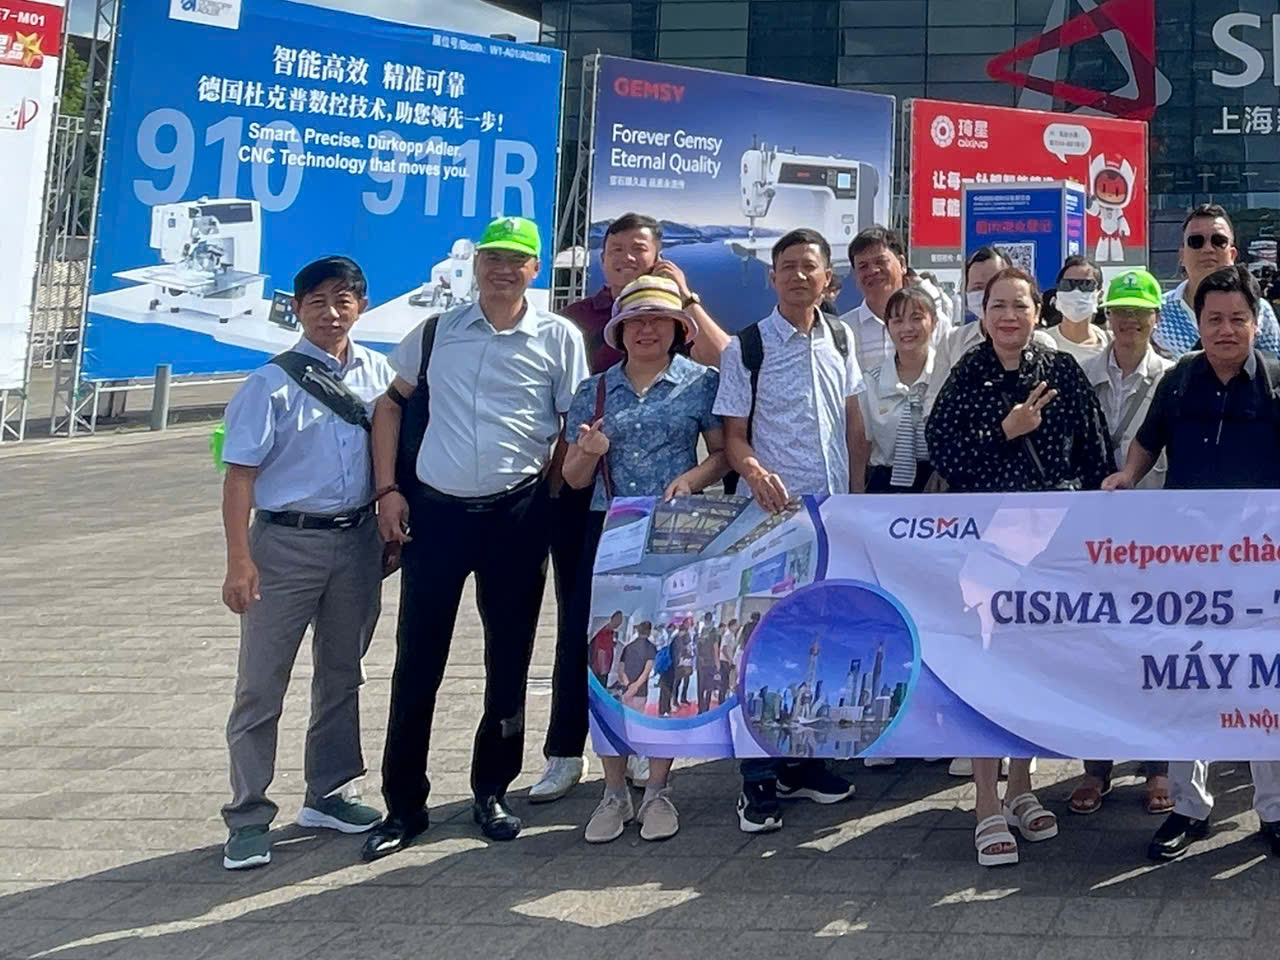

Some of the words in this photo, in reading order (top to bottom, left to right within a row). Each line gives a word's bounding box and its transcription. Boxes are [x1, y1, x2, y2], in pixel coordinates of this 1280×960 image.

[272, 44, 369, 86] 智能高效
[382, 60, 465, 98] 精准可靠
[613, 77, 685, 102] GEMSY
[248, 122, 299, 143] Smart.
[304, 128, 363, 149] Precise.
[425, 143, 462, 158] Adler.
[612, 123, 671, 146] Forever
[674, 130, 722, 156] Gemsy
[238, 145, 275, 164] CNC
[280, 151, 367, 175] Technology
[369, 157, 396, 173] that
[398, 162, 440, 177] moves
[443, 166, 470, 181] you.
[362, 130, 539, 219] 911R
[611, 148, 666, 170] Eternal
[669, 153, 721, 179] Quality
[889, 517, 980, 540] CISMA
[1085, 538, 1223, 569] Vietpower
[991, 589, 1121, 625] CISMA
[1130, 589, 1235, 625] 2025
[1141, 640, 1240, 690] MÁY
[1220, 708, 1247, 728] HÀ
